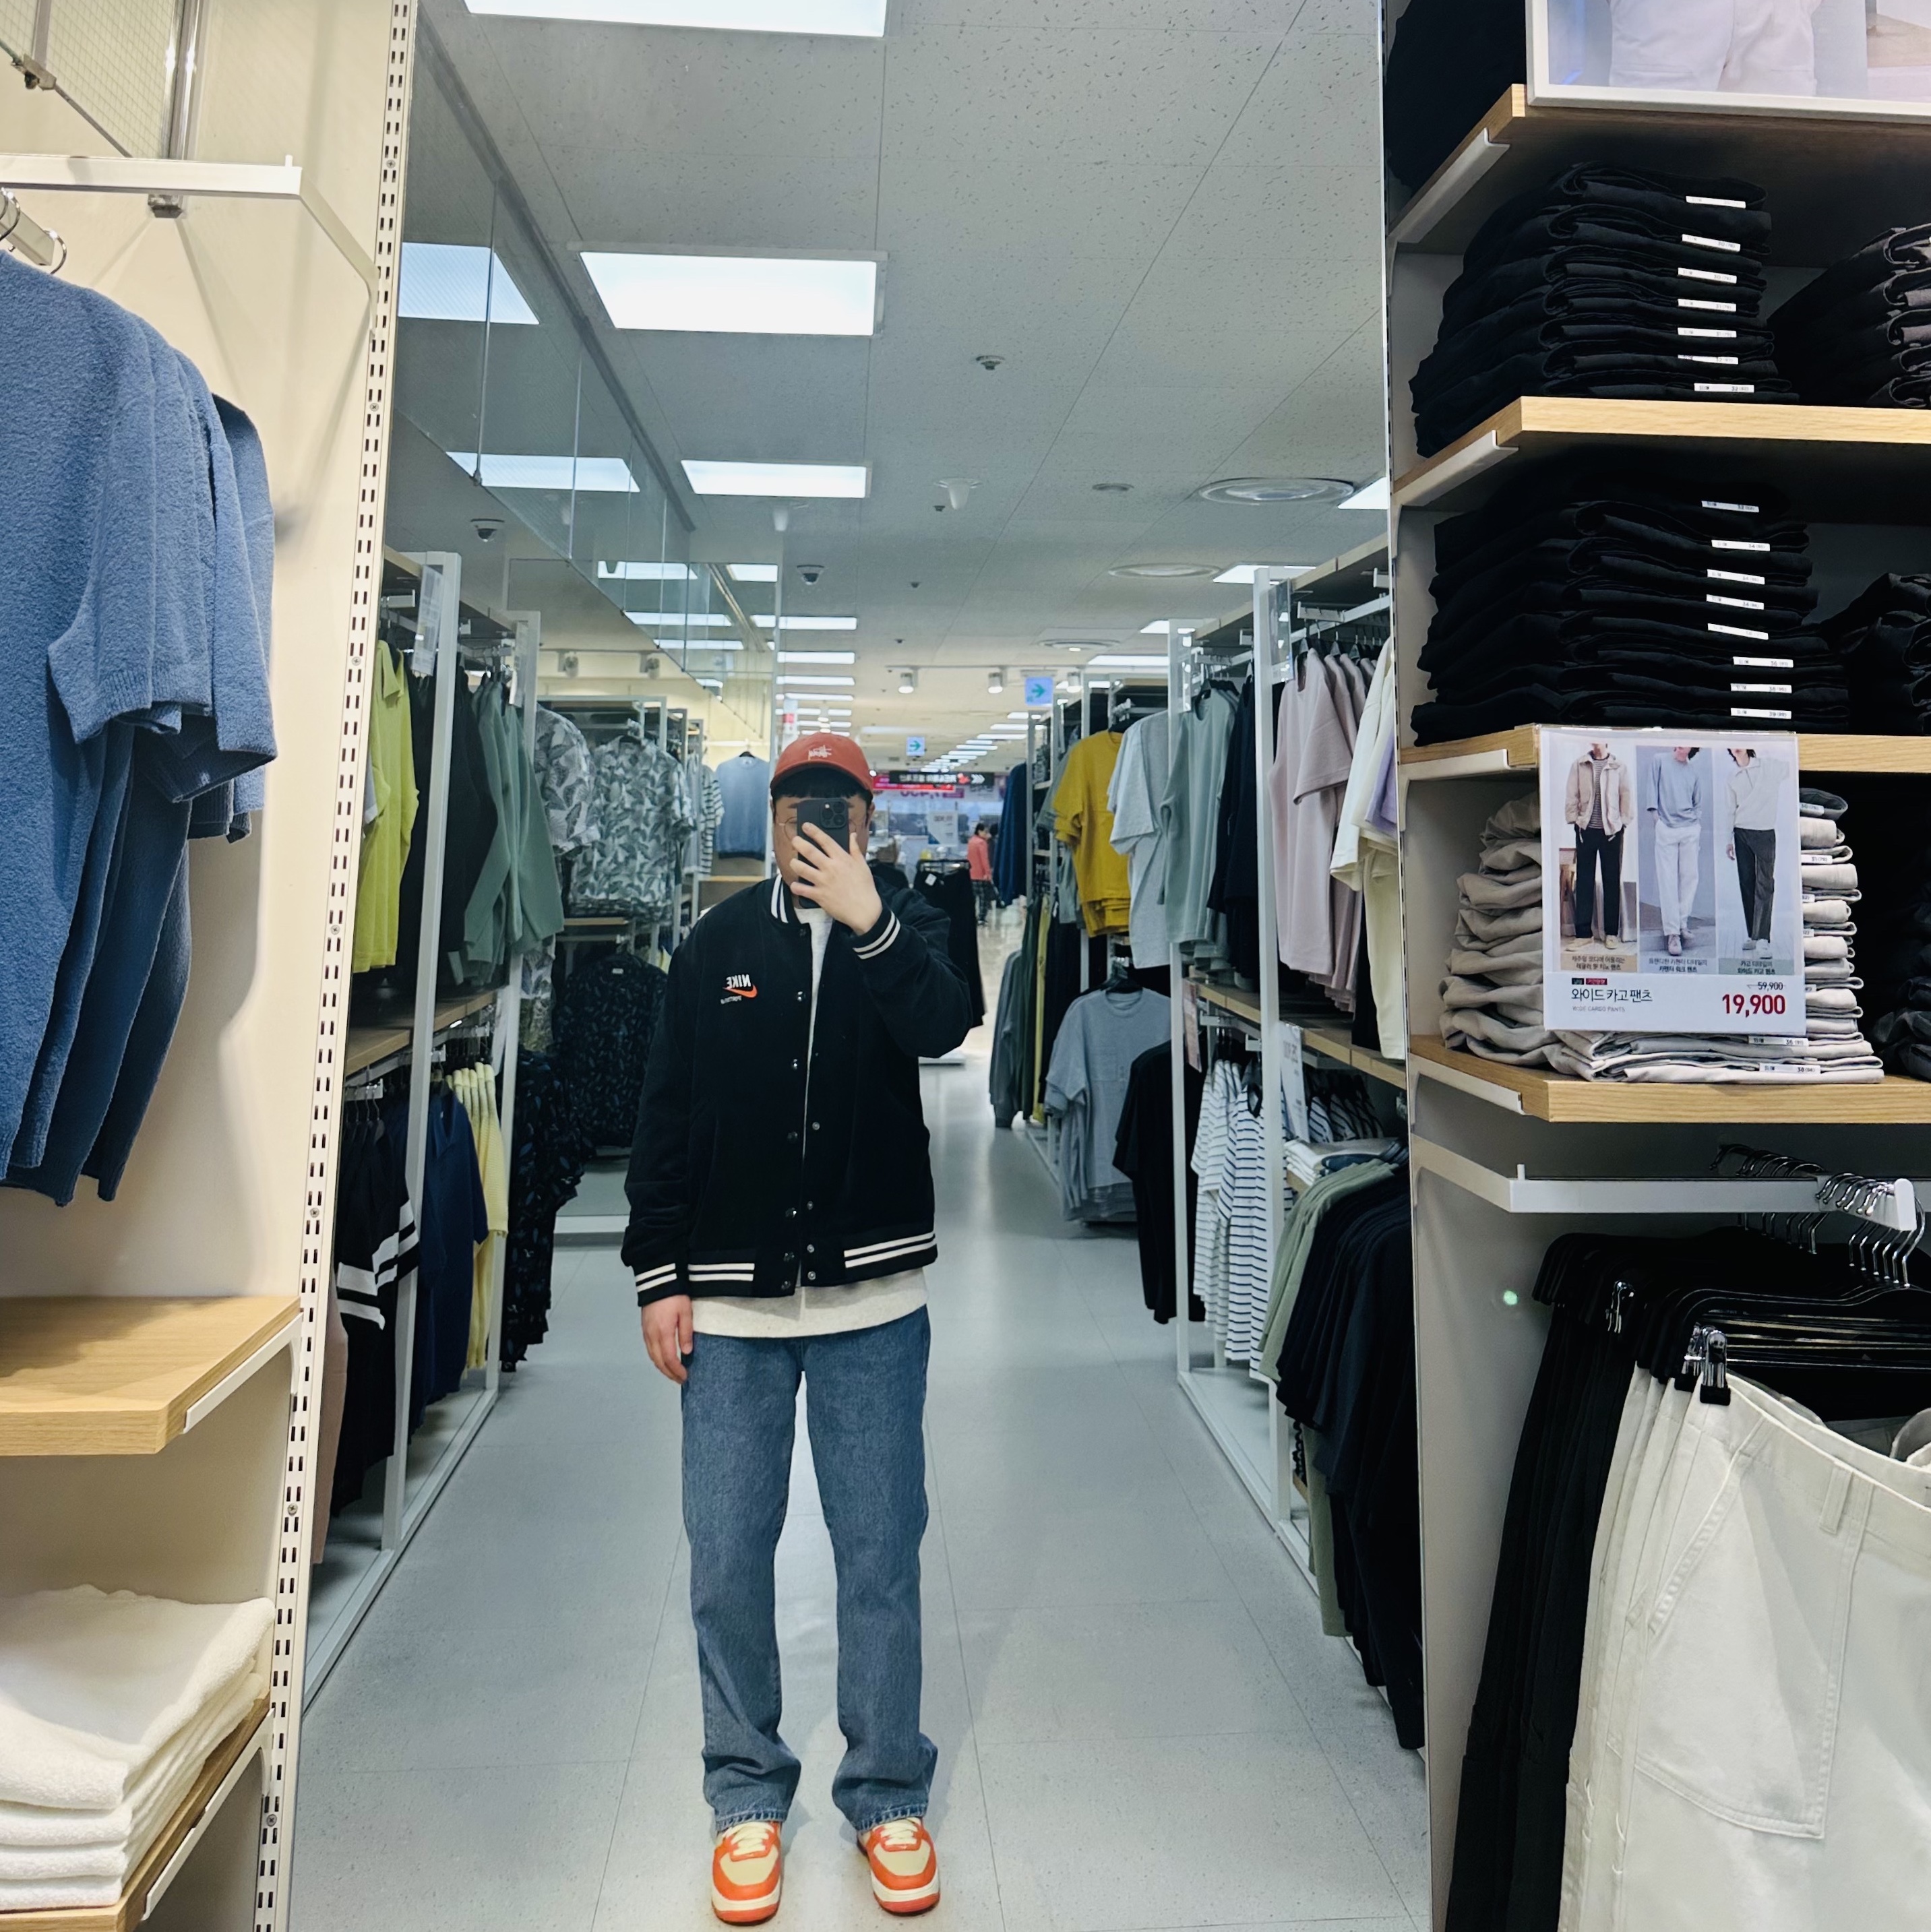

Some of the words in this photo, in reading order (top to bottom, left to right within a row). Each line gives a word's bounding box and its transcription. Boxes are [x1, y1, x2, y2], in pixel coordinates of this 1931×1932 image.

[1757, 981, 1783, 991] 59,900
[1571, 988, 1605, 1002] 와이드
[1607, 989, 1629, 1003] 카고
[1630, 989, 1653, 1003] 팬츠
[1722, 994, 1785, 1018] 19,900
